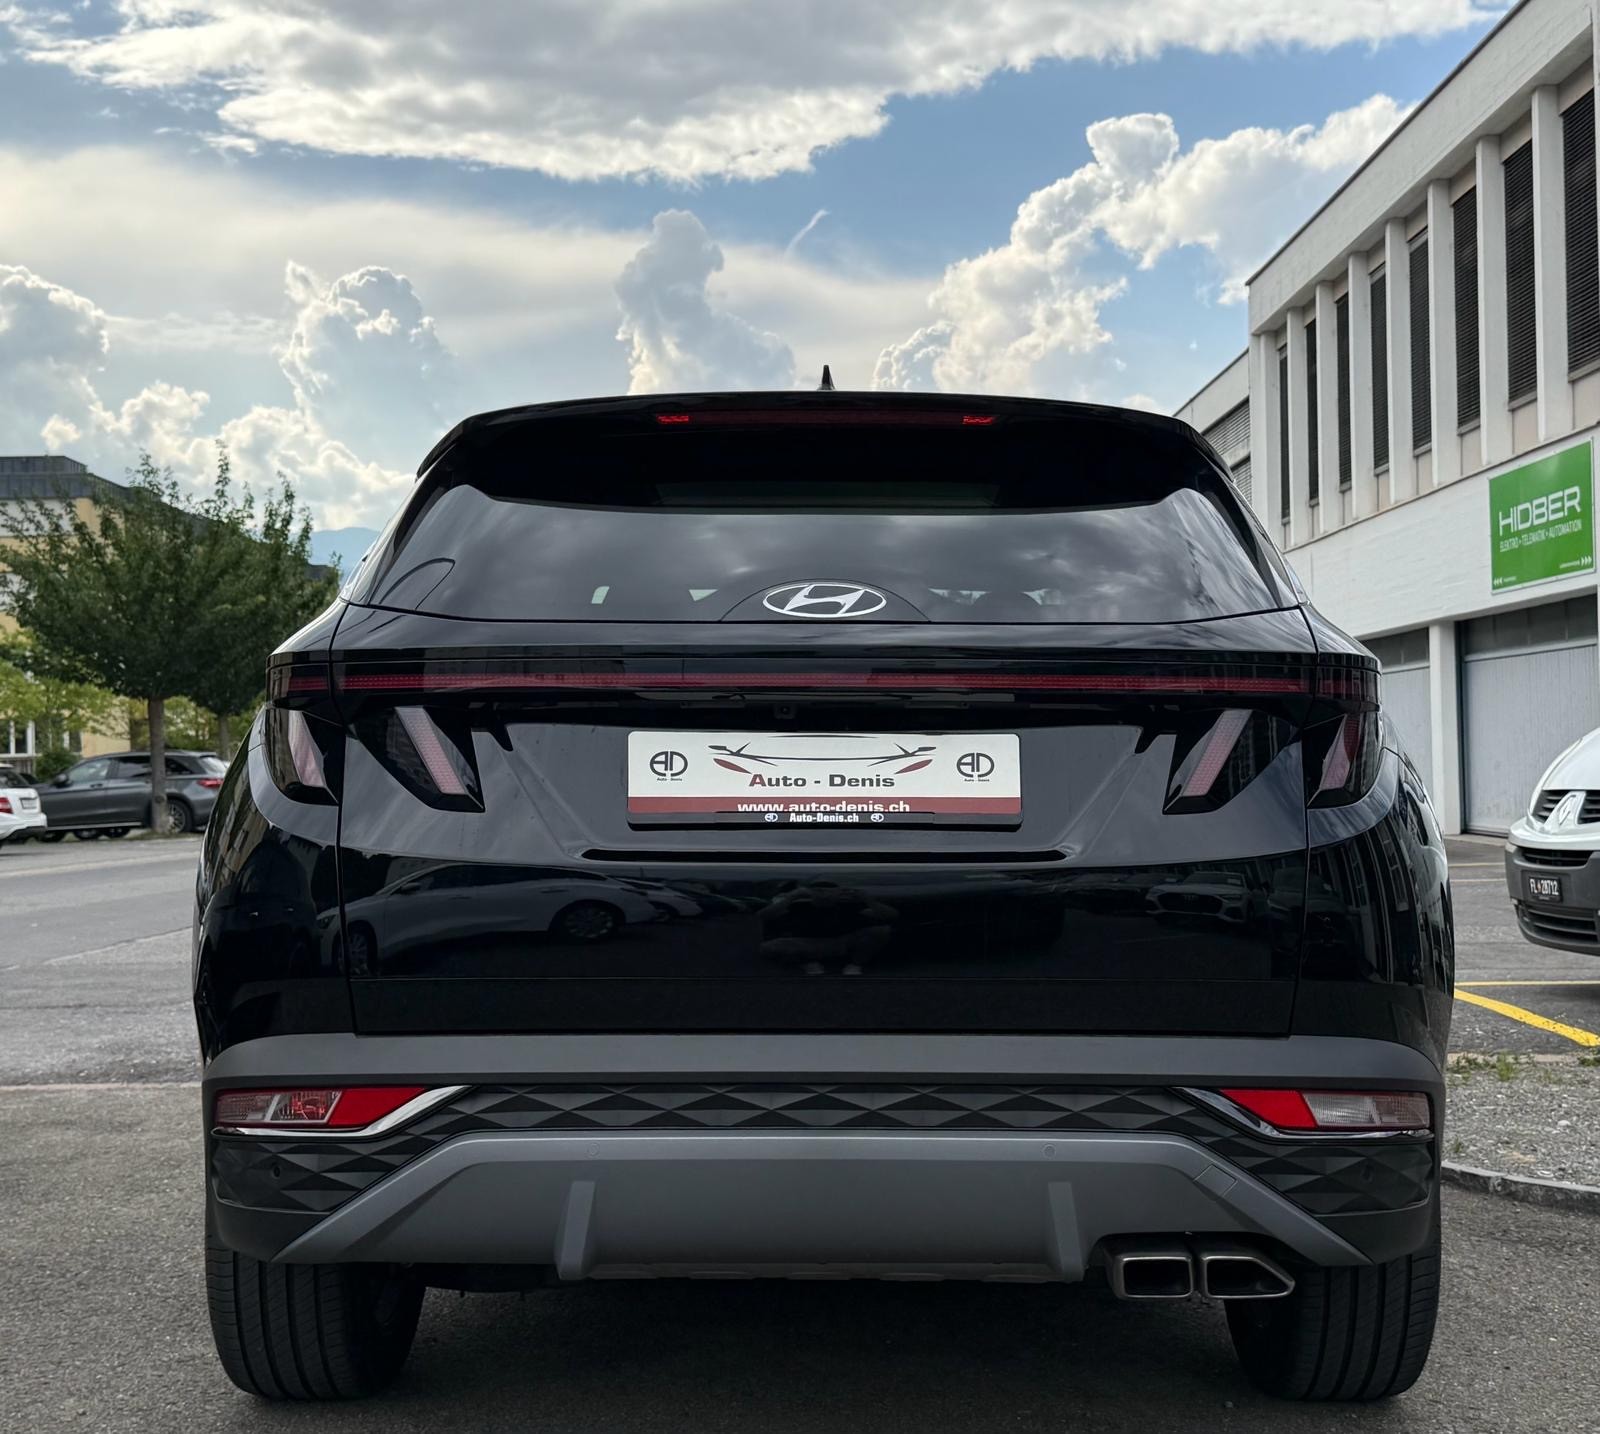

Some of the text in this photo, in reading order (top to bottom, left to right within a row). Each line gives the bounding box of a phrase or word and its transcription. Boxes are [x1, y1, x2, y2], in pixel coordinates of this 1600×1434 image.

[1499, 485, 1581, 536] HIDBER
[1549, 519, 1582, 539] AUTOMATION
[750, 774, 807, 787] Auto
[829, 774, 895, 787] Denis
[738, 800, 910, 812] www.auto-denis.ch
[789, 813, 859, 823] Auto-Denis.ch
